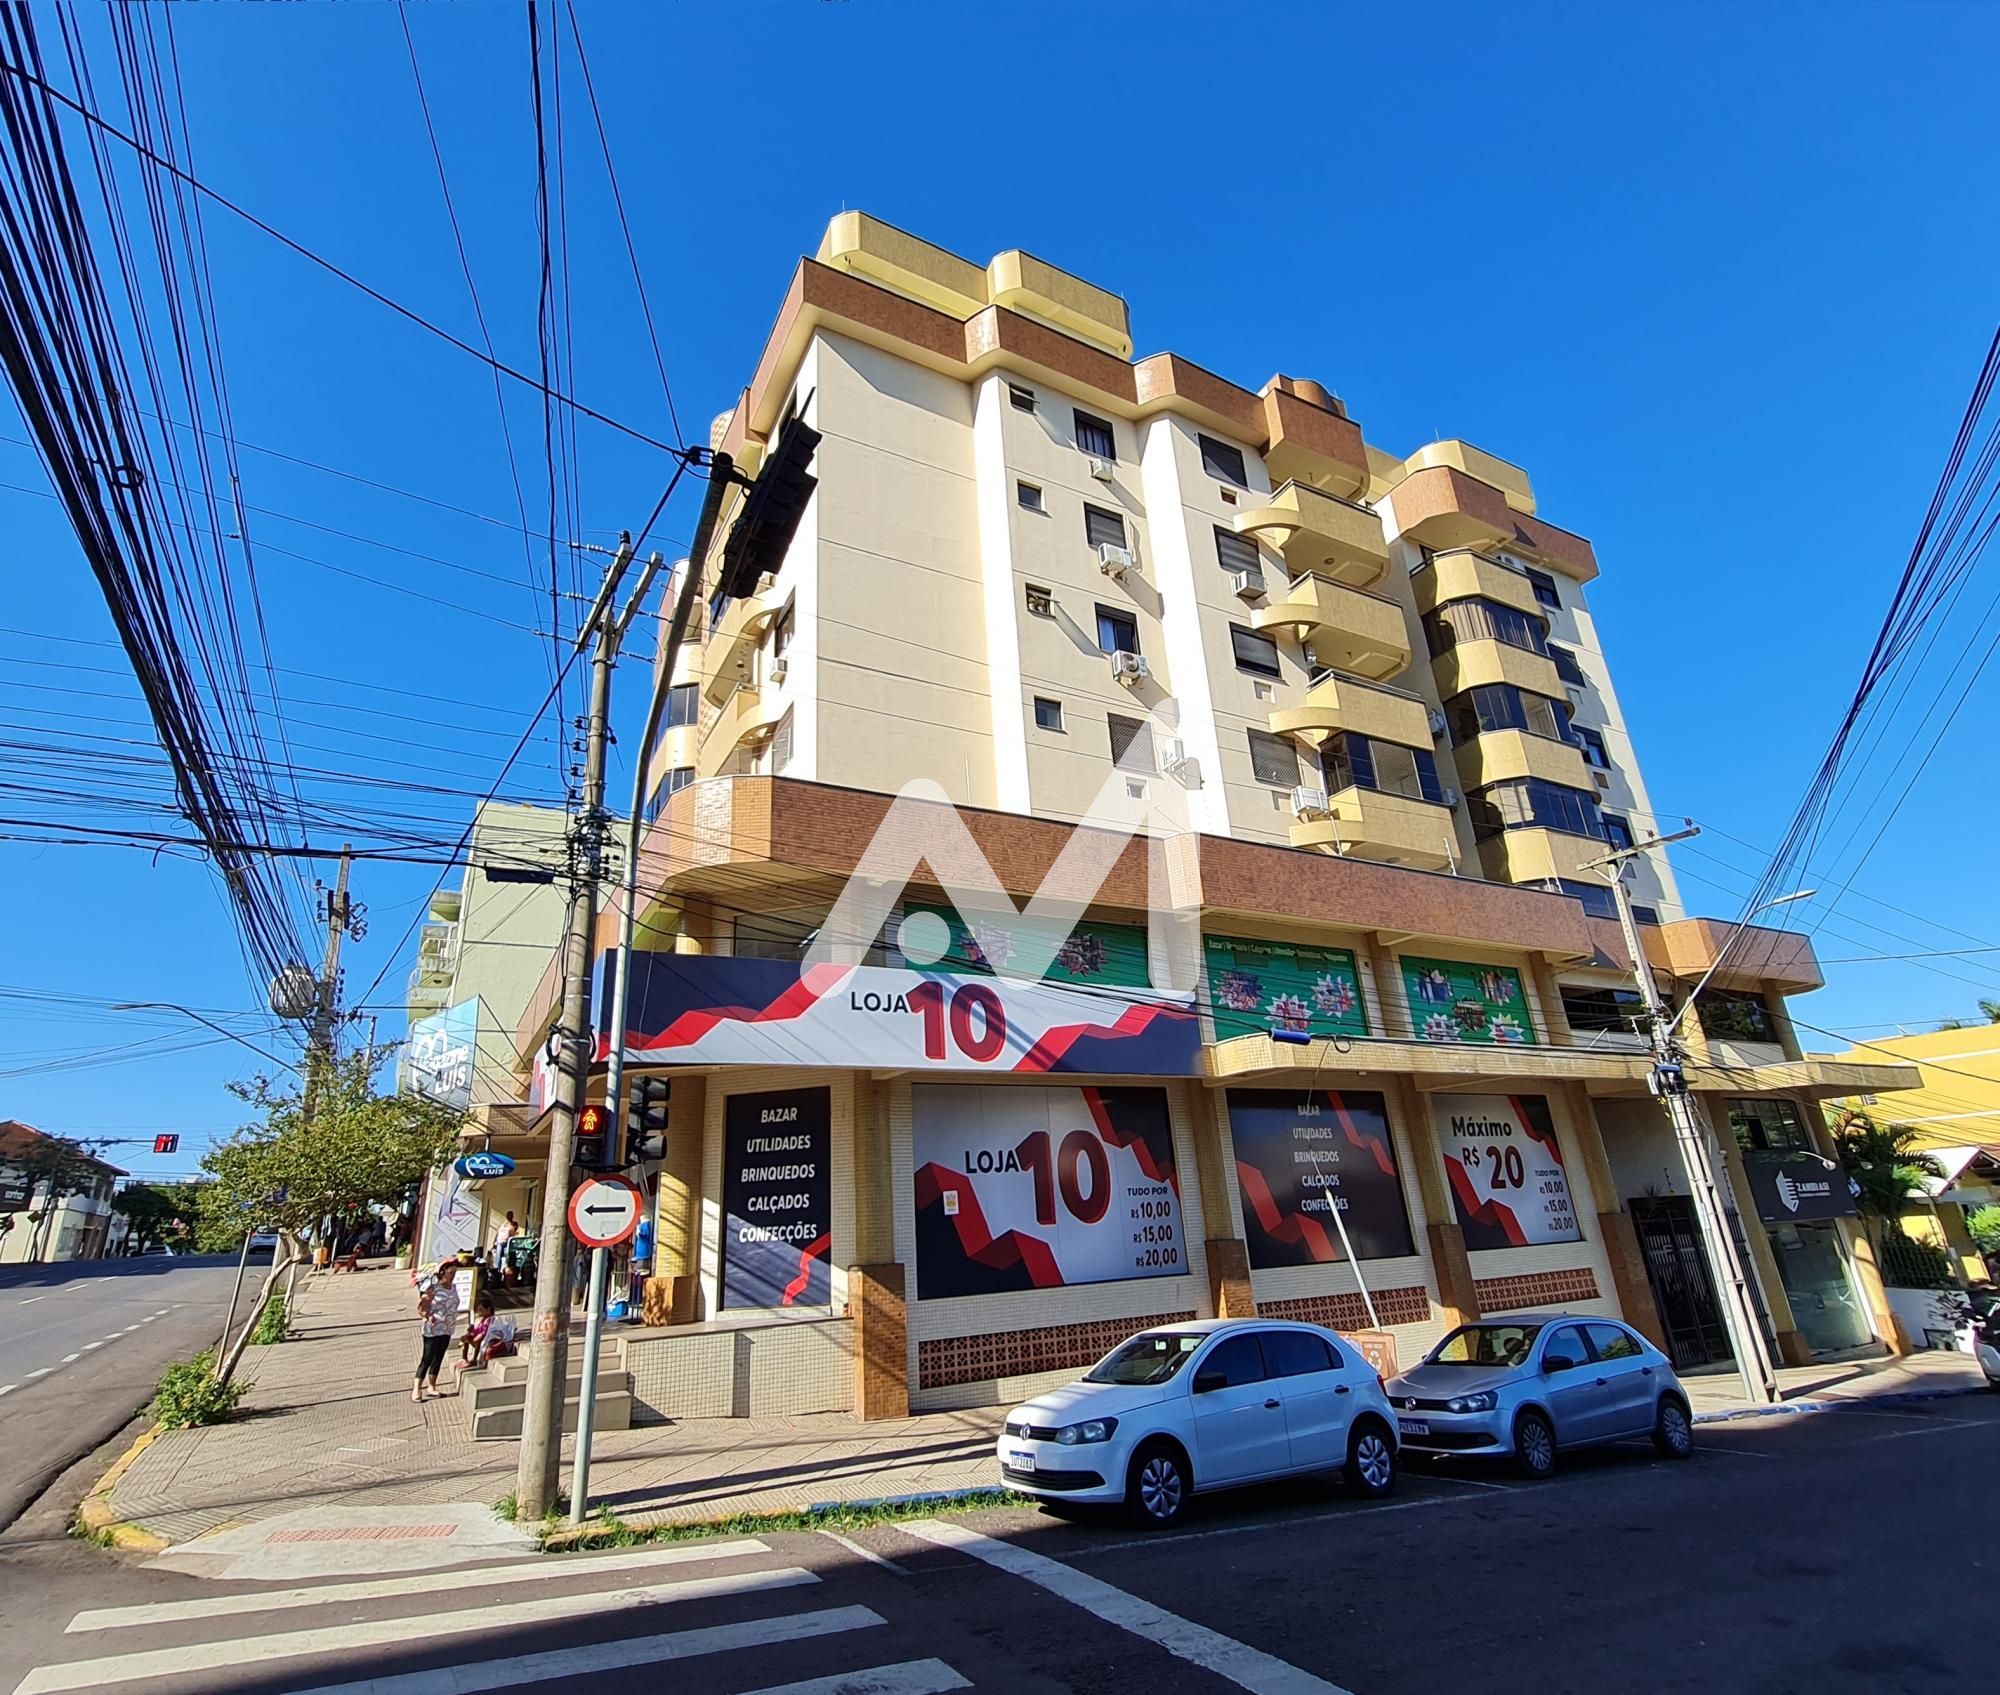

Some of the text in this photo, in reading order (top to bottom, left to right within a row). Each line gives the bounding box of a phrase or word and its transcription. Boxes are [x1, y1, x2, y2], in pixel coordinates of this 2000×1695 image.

[851, 980, 1006, 1062] LOJA 10
[761, 1107, 797, 1123] BAZAR
[1293, 1127, 1333, 1139] UTILIDADES
[1451, 1116, 1512, 1137] Máximo
[747, 1135, 811, 1152] UTILIDADES
[1294, 1151, 1339, 1163] BRINQUEDOS
[741, 1164, 815, 1182] BRINQUEDOS
[1462, 1146, 1525, 1189] R$ 20
[965, 1130, 1111, 1225] LOJA 10
[1302, 1174, 1340, 1189] CALÇADOS
[1127, 1187, 1168, 1196] TUDO POR
[748, 1194, 810, 1213] CALÇADOS
[1301, 1196, 1348, 1211] CONFECÕES
[739, 1221, 817, 1243] CONFECÇÕES
